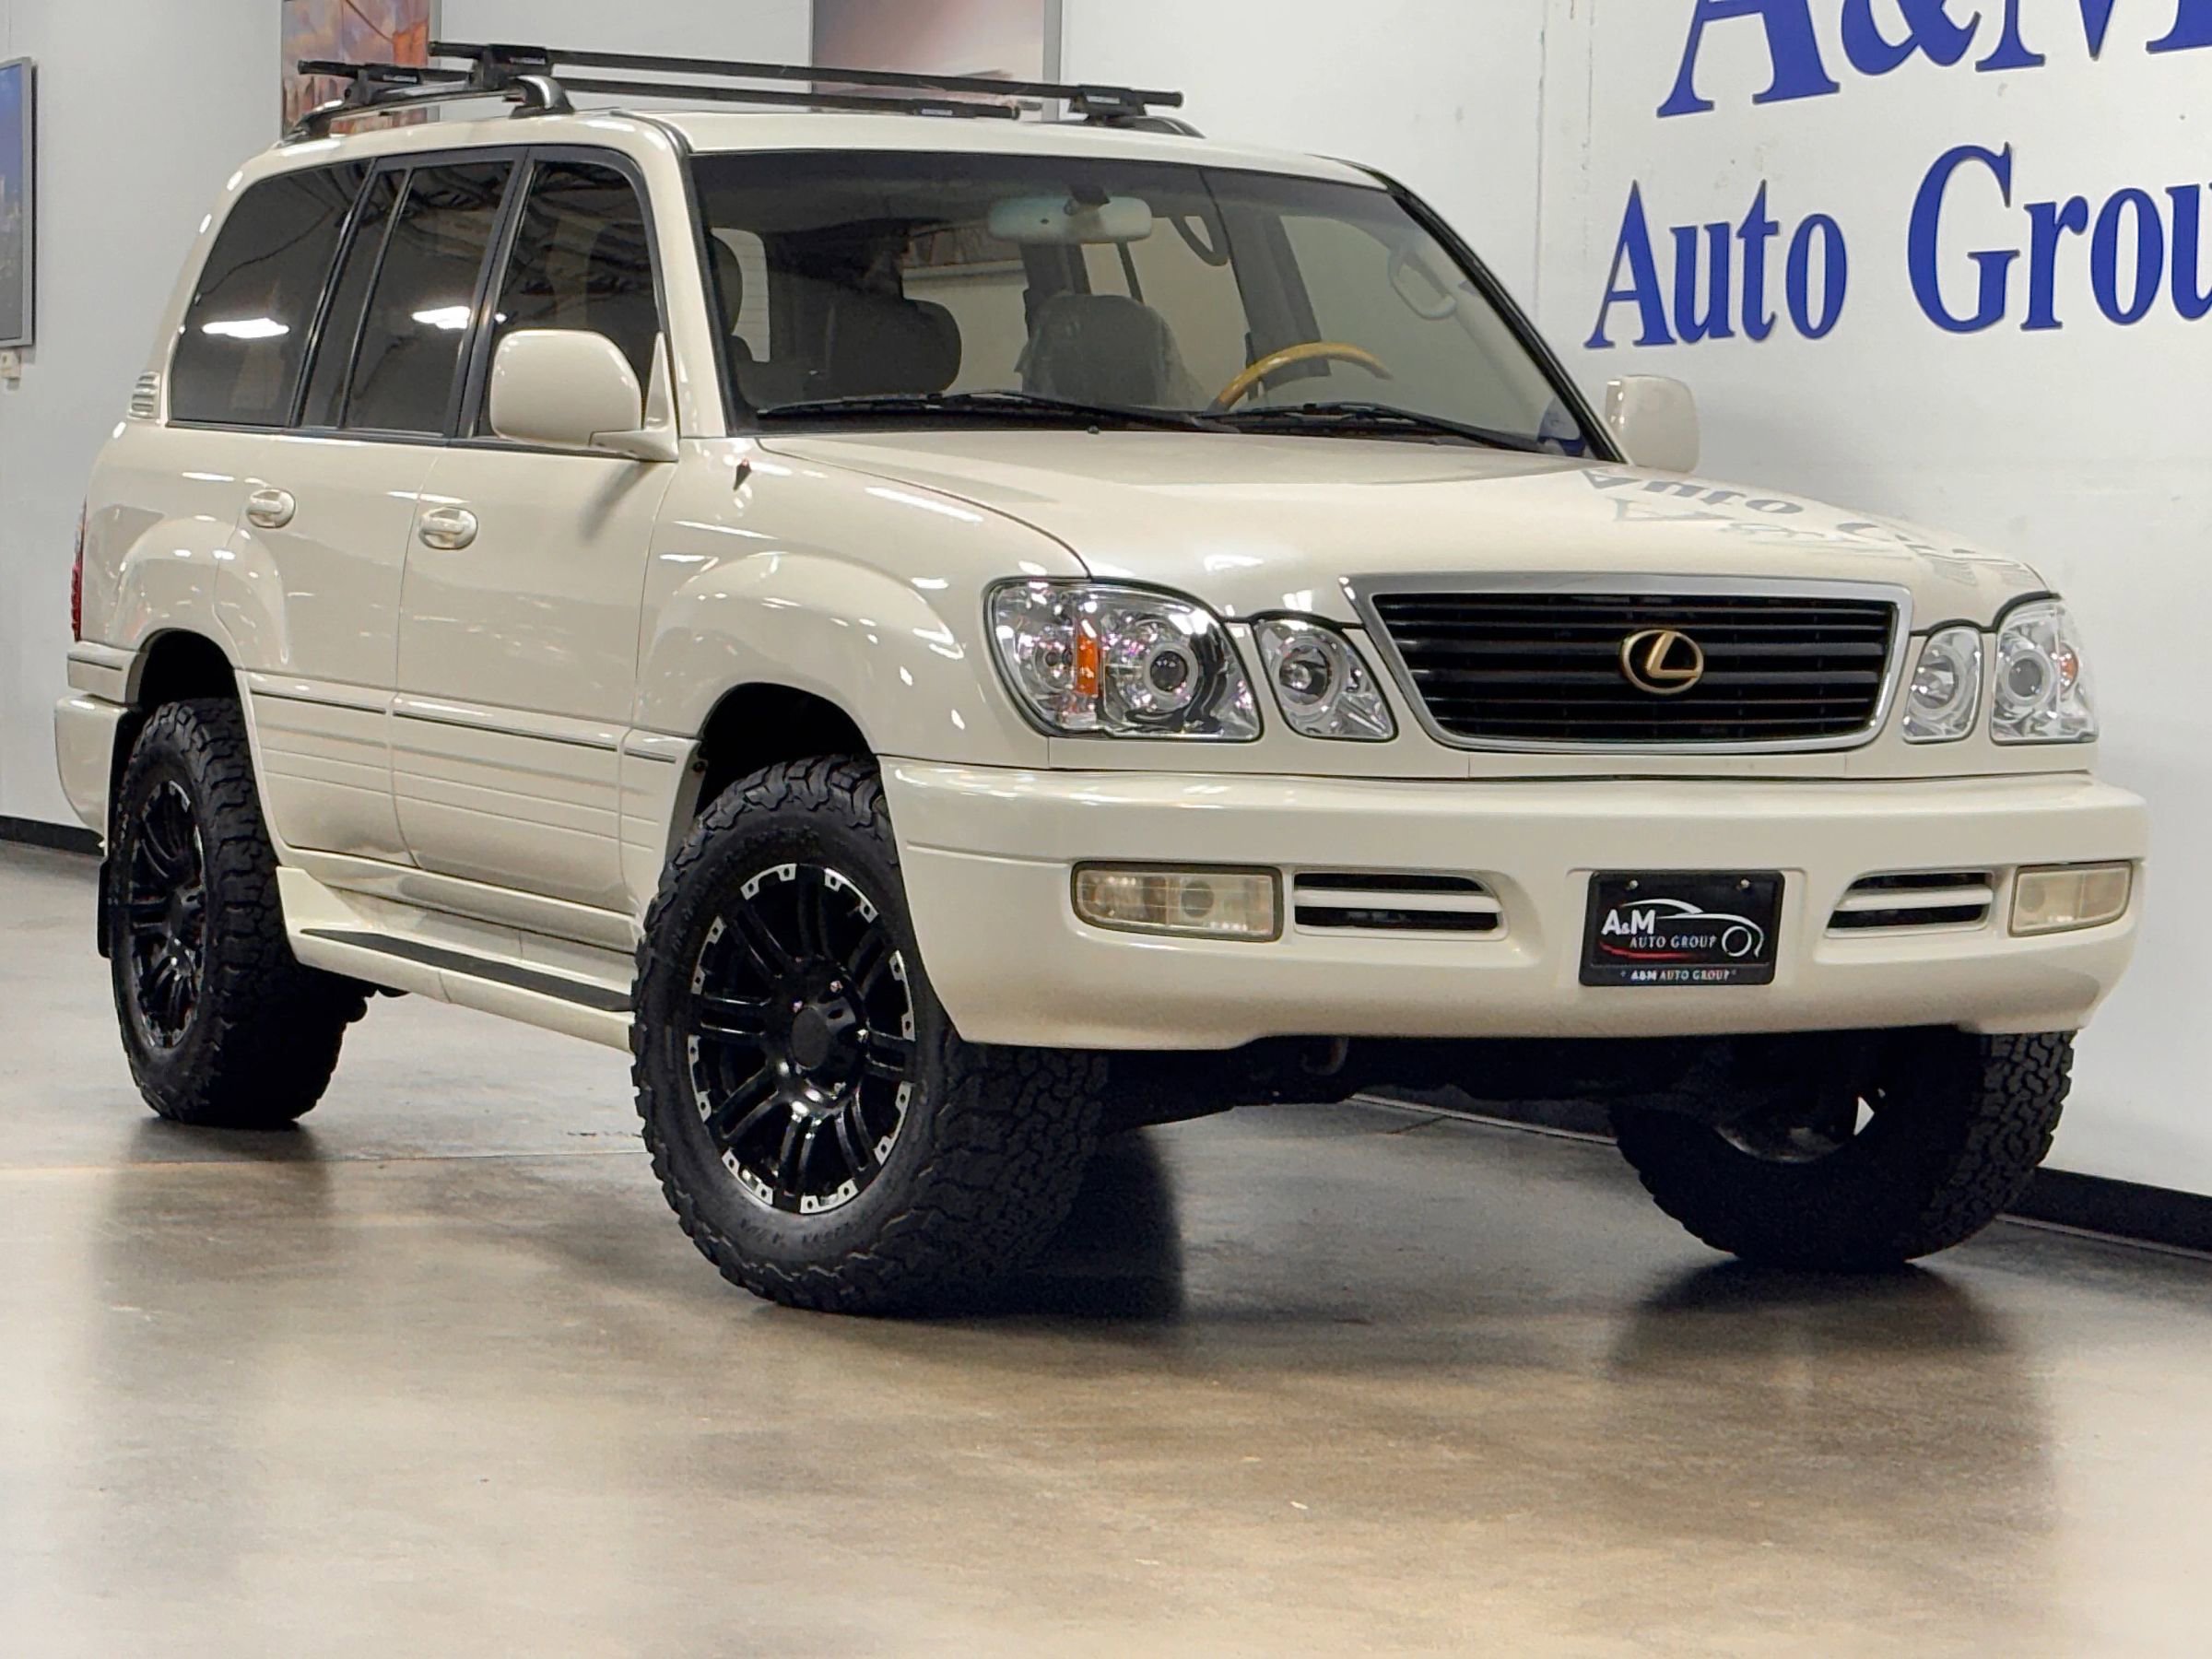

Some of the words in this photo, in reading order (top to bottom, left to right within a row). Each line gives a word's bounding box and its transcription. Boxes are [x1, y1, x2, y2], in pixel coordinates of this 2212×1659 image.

[1583, 179, 1848, 348] Auto
[1601, 909, 1655, 935] A&M
[1630, 935, 1666, 948] AUTO
[1670, 935, 1717, 948] GROUP
[1659, 970, 1689, 981] AUTO
[1692, 969, 1730, 981] GROUP
